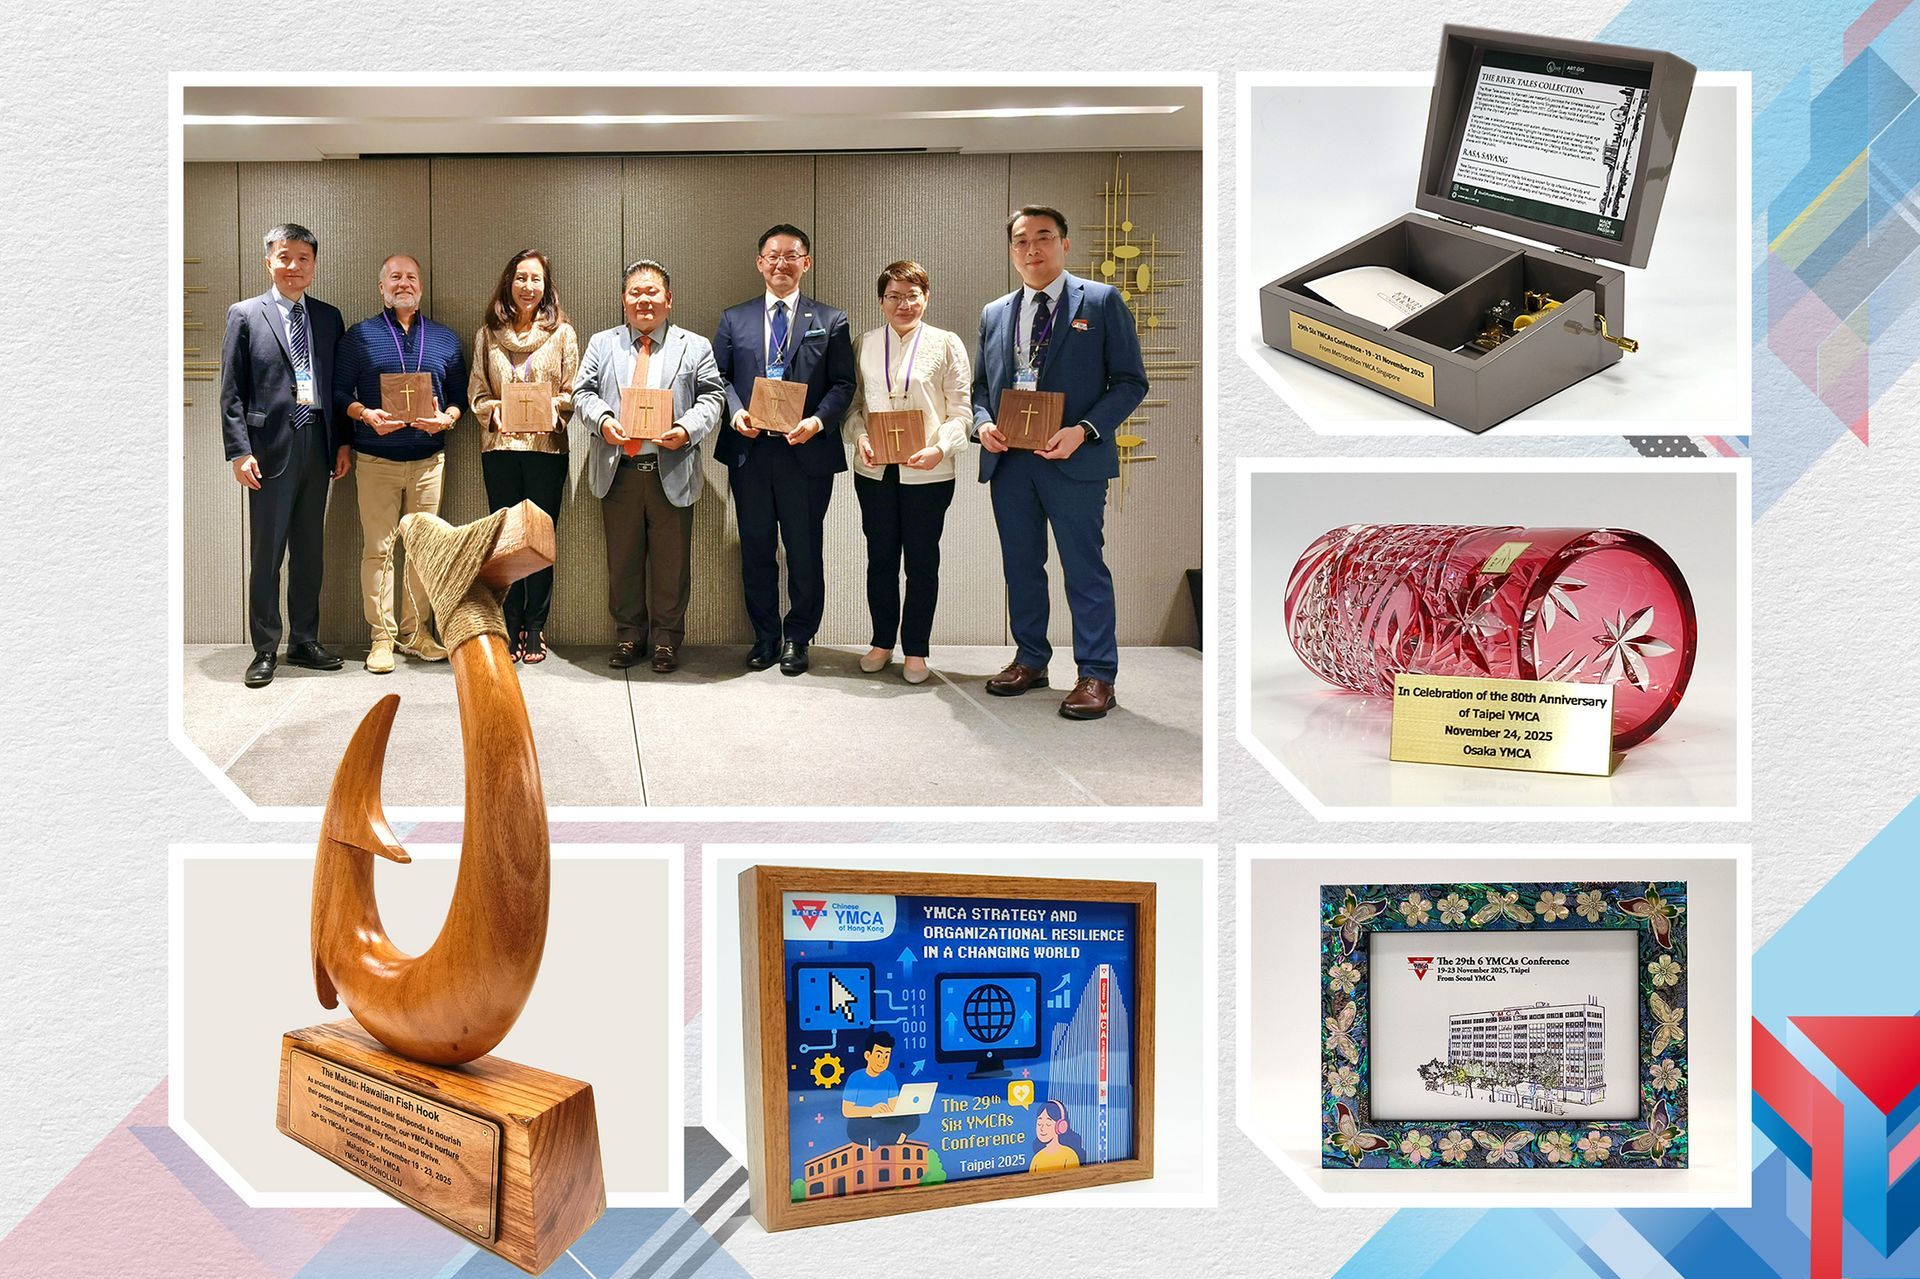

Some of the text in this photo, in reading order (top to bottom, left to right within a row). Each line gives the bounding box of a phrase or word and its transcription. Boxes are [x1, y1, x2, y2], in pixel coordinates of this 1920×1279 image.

[1482, 73, 1495, 82] THE
[1496, 75, 1516, 85] RIVER
[1517, 78, 1538, 88] TALES
[1538, 81, 1585, 95] COLLECTION
[1463, 148, 1509, 164] RASA SAYANG
[1297, 322, 1309, 332] 29th
[1309, 327, 1317, 336] Six
[1316, 330, 1333, 342] YMCAs
[1334, 337, 1362, 354] Conference
[1365, 349, 1372, 357] 19
[1375, 353, 1382, 361] 21
[1382, 356, 1410, 372] November
[1411, 367, 1425, 378] 2025
[1319, 344, 1401, 382] From Metropolitan YMCA Singapore
[1398, 686, 1607, 709] In Celebration of the 80th Anniversary
[1459, 708, 1540, 722] of Taipei YMCA
[1445, 725, 1553, 741] November 24, 2025
[1463, 745, 1532, 759] Osaka YMCA
[834, 910, 884, 925] YMCA
[923, 906, 1077, 922] YMCA STRATEGY AND
[847, 925, 865, 933] Hong
[867, 925, 885, 933] Kong
[923, 926, 1125, 941] ORGANIZATIONAL RESILIENCE
[923, 945, 1080, 959] IN A CHANGING WORLD
[1437, 956, 1570, 966] The 29th 6 YMCAs Conference
[1510, 967, 1530, 975] Taipei
[902, 989, 926, 1001] 010
[911, 1004, 925, 1017] 11
[902, 1021, 926, 1033] 000
[903, 1036, 926, 1049] 110
[322, 1066, 440, 1122] The Makau: Hawaiian Fish Hook
[941, 1095, 1001, 1113] The 29th
[314, 1079, 331, 1090] ancient
[331, 1085, 355, 1101] Hawaiians
[356, 1097, 381, 1112] sustained
[382, 1107, 395, 1118] their
[396, 1113, 426, 1132] fishponds
[427, 1126, 434, 1135] to
[435, 1131, 462, 1147] nourish
[308, 1086, 318, 1096] their
[318, 1092, 333, 1103] people
[344, 1104, 373, 1121] generations
[381, 1120, 398, 1134] come,
[399, 1129, 410, 1137] our
[411, 1132, 433, 1148] YMCAs
[434, 1144, 460, 1160] nurture
[941, 1113, 1014, 1132] Six YMCAs
[323, 1105, 348, 1122] community
[348, 1117, 364, 1129] where
[372, 1129, 384, 1139] may
[385, 1133, 407, 1149] flourish
[407, 1145, 419, 1155] and
[420, 1151, 441, 1165] thrive.
[941, 1132, 1025, 1151] Conference
[328, 1119, 345, 1132] YMCAs
[345, 1128, 375, 1147] Conference
[381, 1145, 411, 1165] November
[412, 1160, 419, 1170] 19
[424, 1166, 434, 1178] 23,
[435, 1172, 452, 1186] 2025
[347, 1139, 401, 1174] Mahalo Taipei YMCA
[345, 1151, 403, 1187] YMCA OF HONOLULU
[960, 1153, 1026, 1172] Taipei 2025
